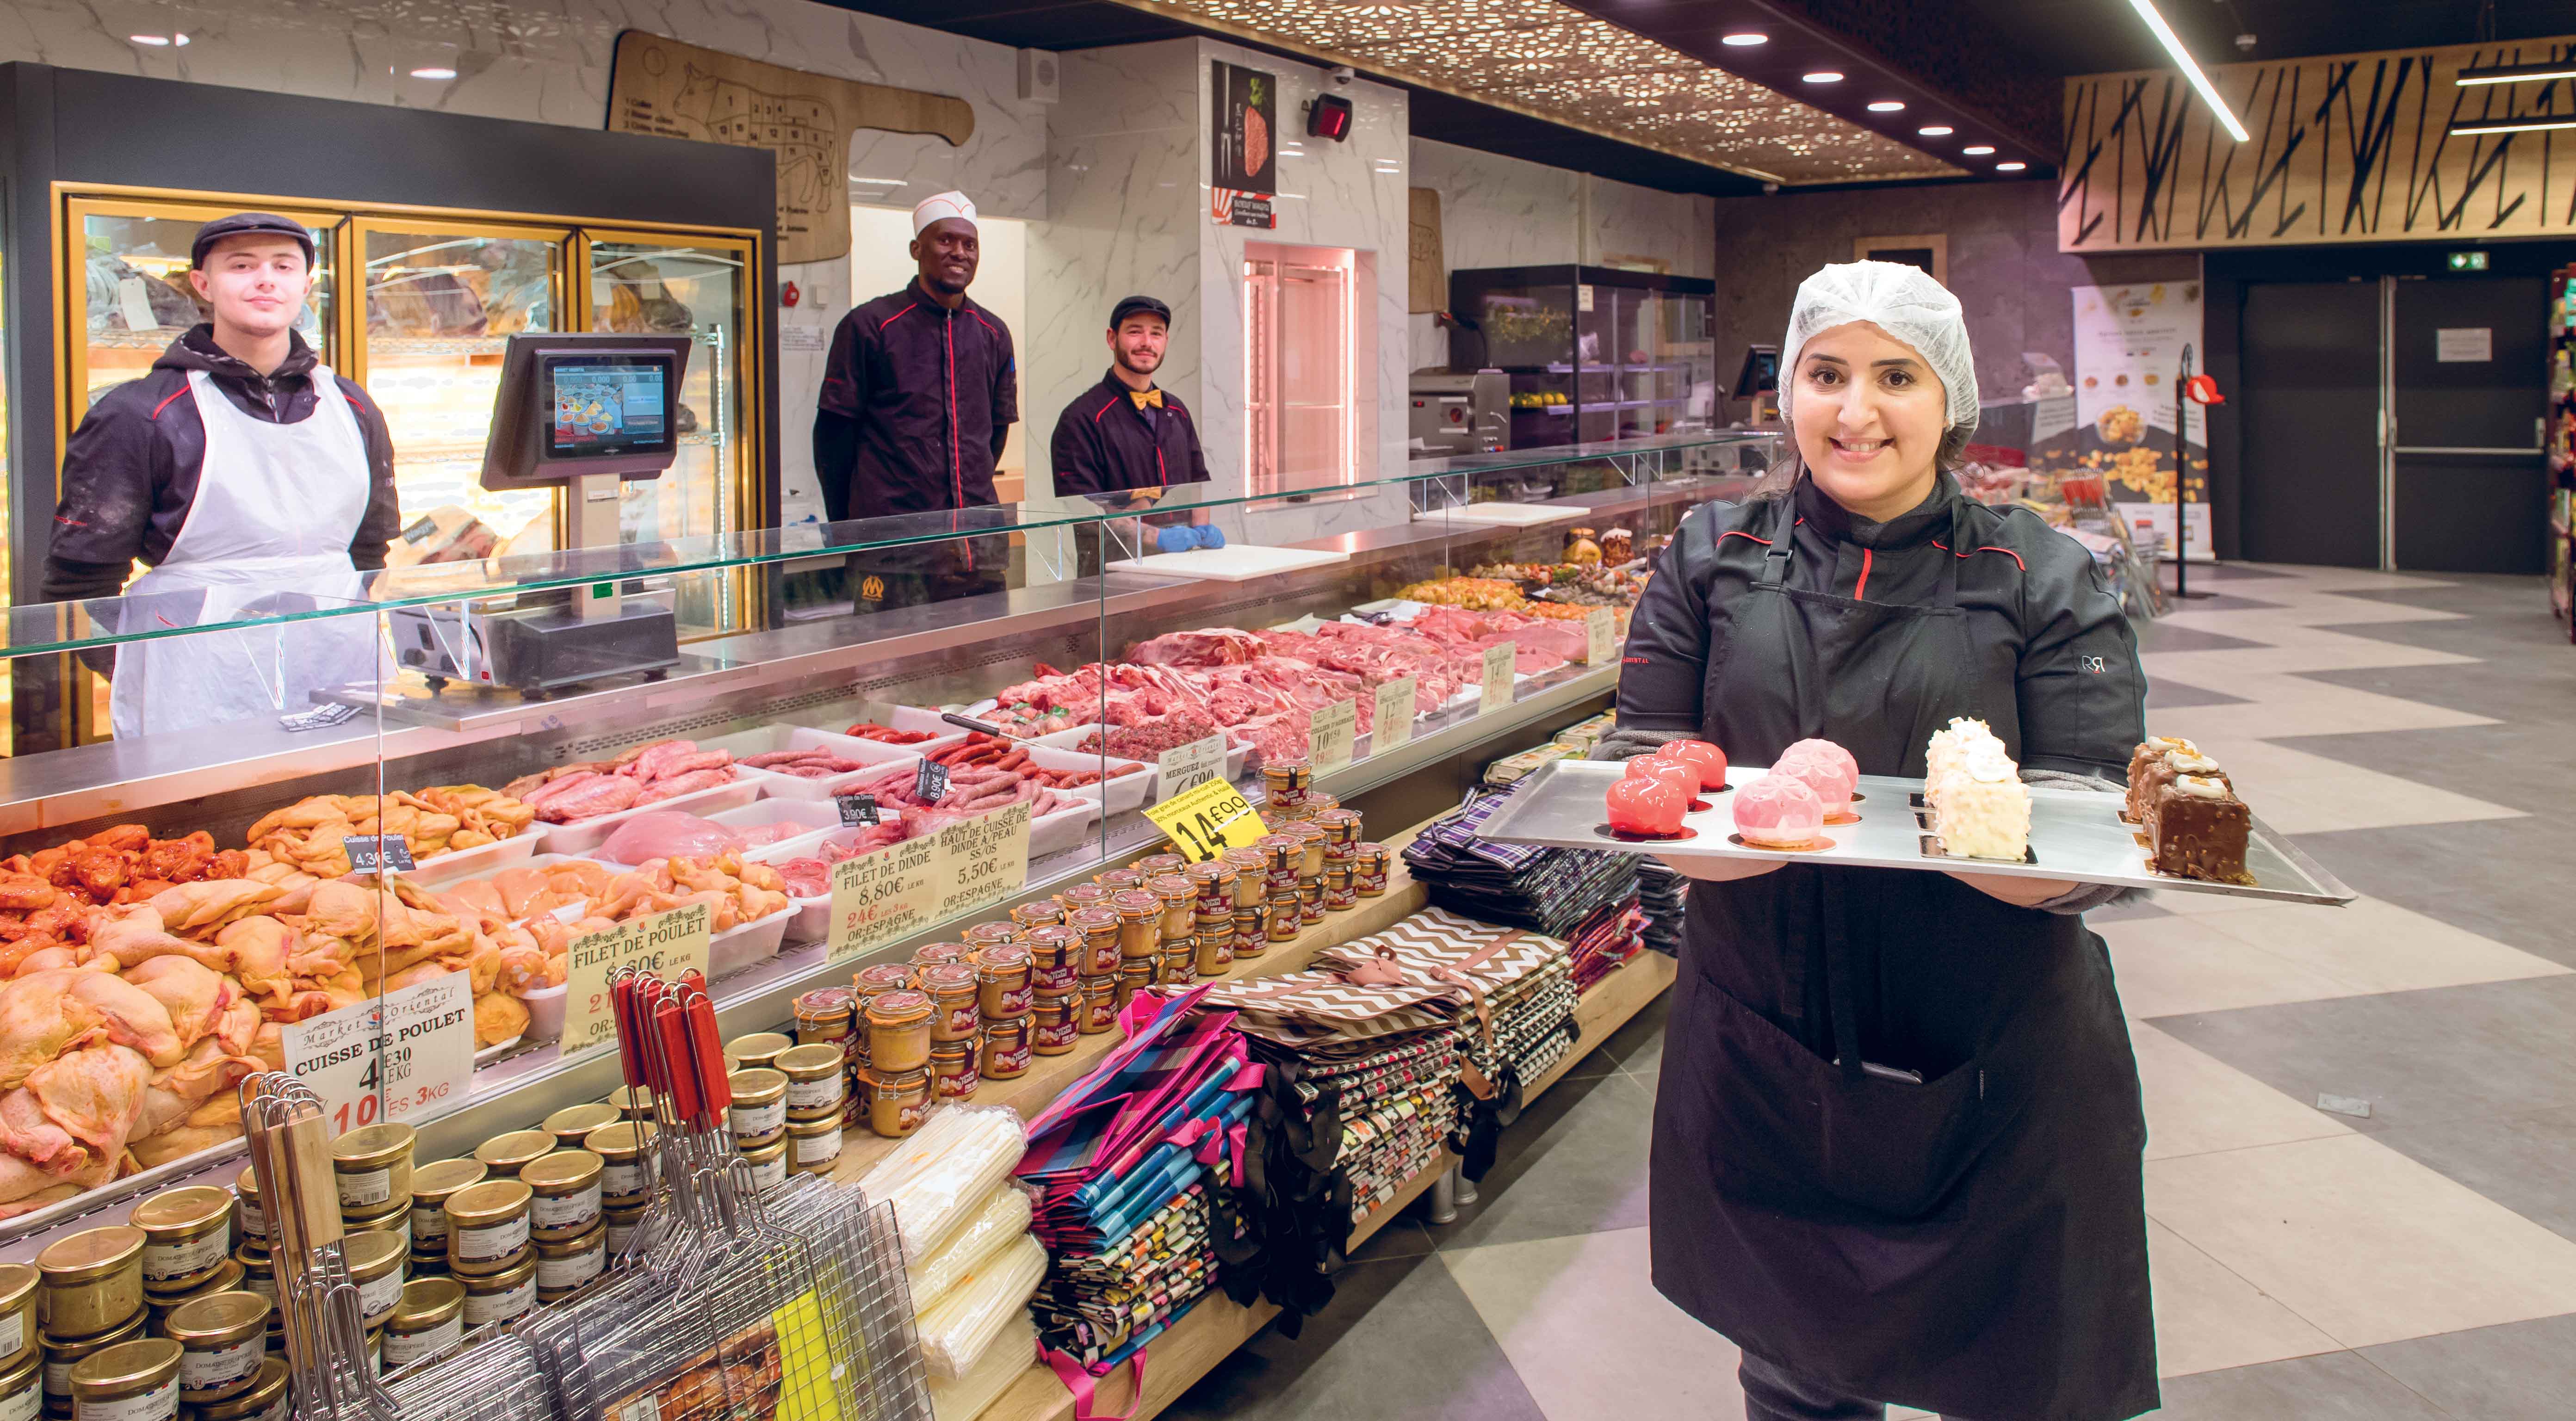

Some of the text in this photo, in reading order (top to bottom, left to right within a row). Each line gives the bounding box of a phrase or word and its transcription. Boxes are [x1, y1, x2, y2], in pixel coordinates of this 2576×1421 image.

[728, 95, 733, 106] 1
[1166, 762, 1199, 780] MERGUEZ
[941, 812, 1028, 847] HAUT DE CUISSE DE
[951, 826, 1017, 856] DINDE A/PEAU
[970, 843, 997, 861] SS/OS
[844, 851, 931, 890] FILET DE DINDE
[958, 858, 998, 884] 5,50€
[859, 877, 904, 906] 8,80€
[944, 878, 1003, 908] OR:ESPAGNE
[847, 904, 878, 929] 24€
[848, 908, 916, 942] OR:ESPAGNE
[574, 917, 705, 969] FILET DE POULET
[669, 957, 679, 966] LE
[681, 954, 691, 963] KG
[303, 987, 455, 1046] Market Oriental
[295, 1008, 465, 1077] CUISSE DE POULET
